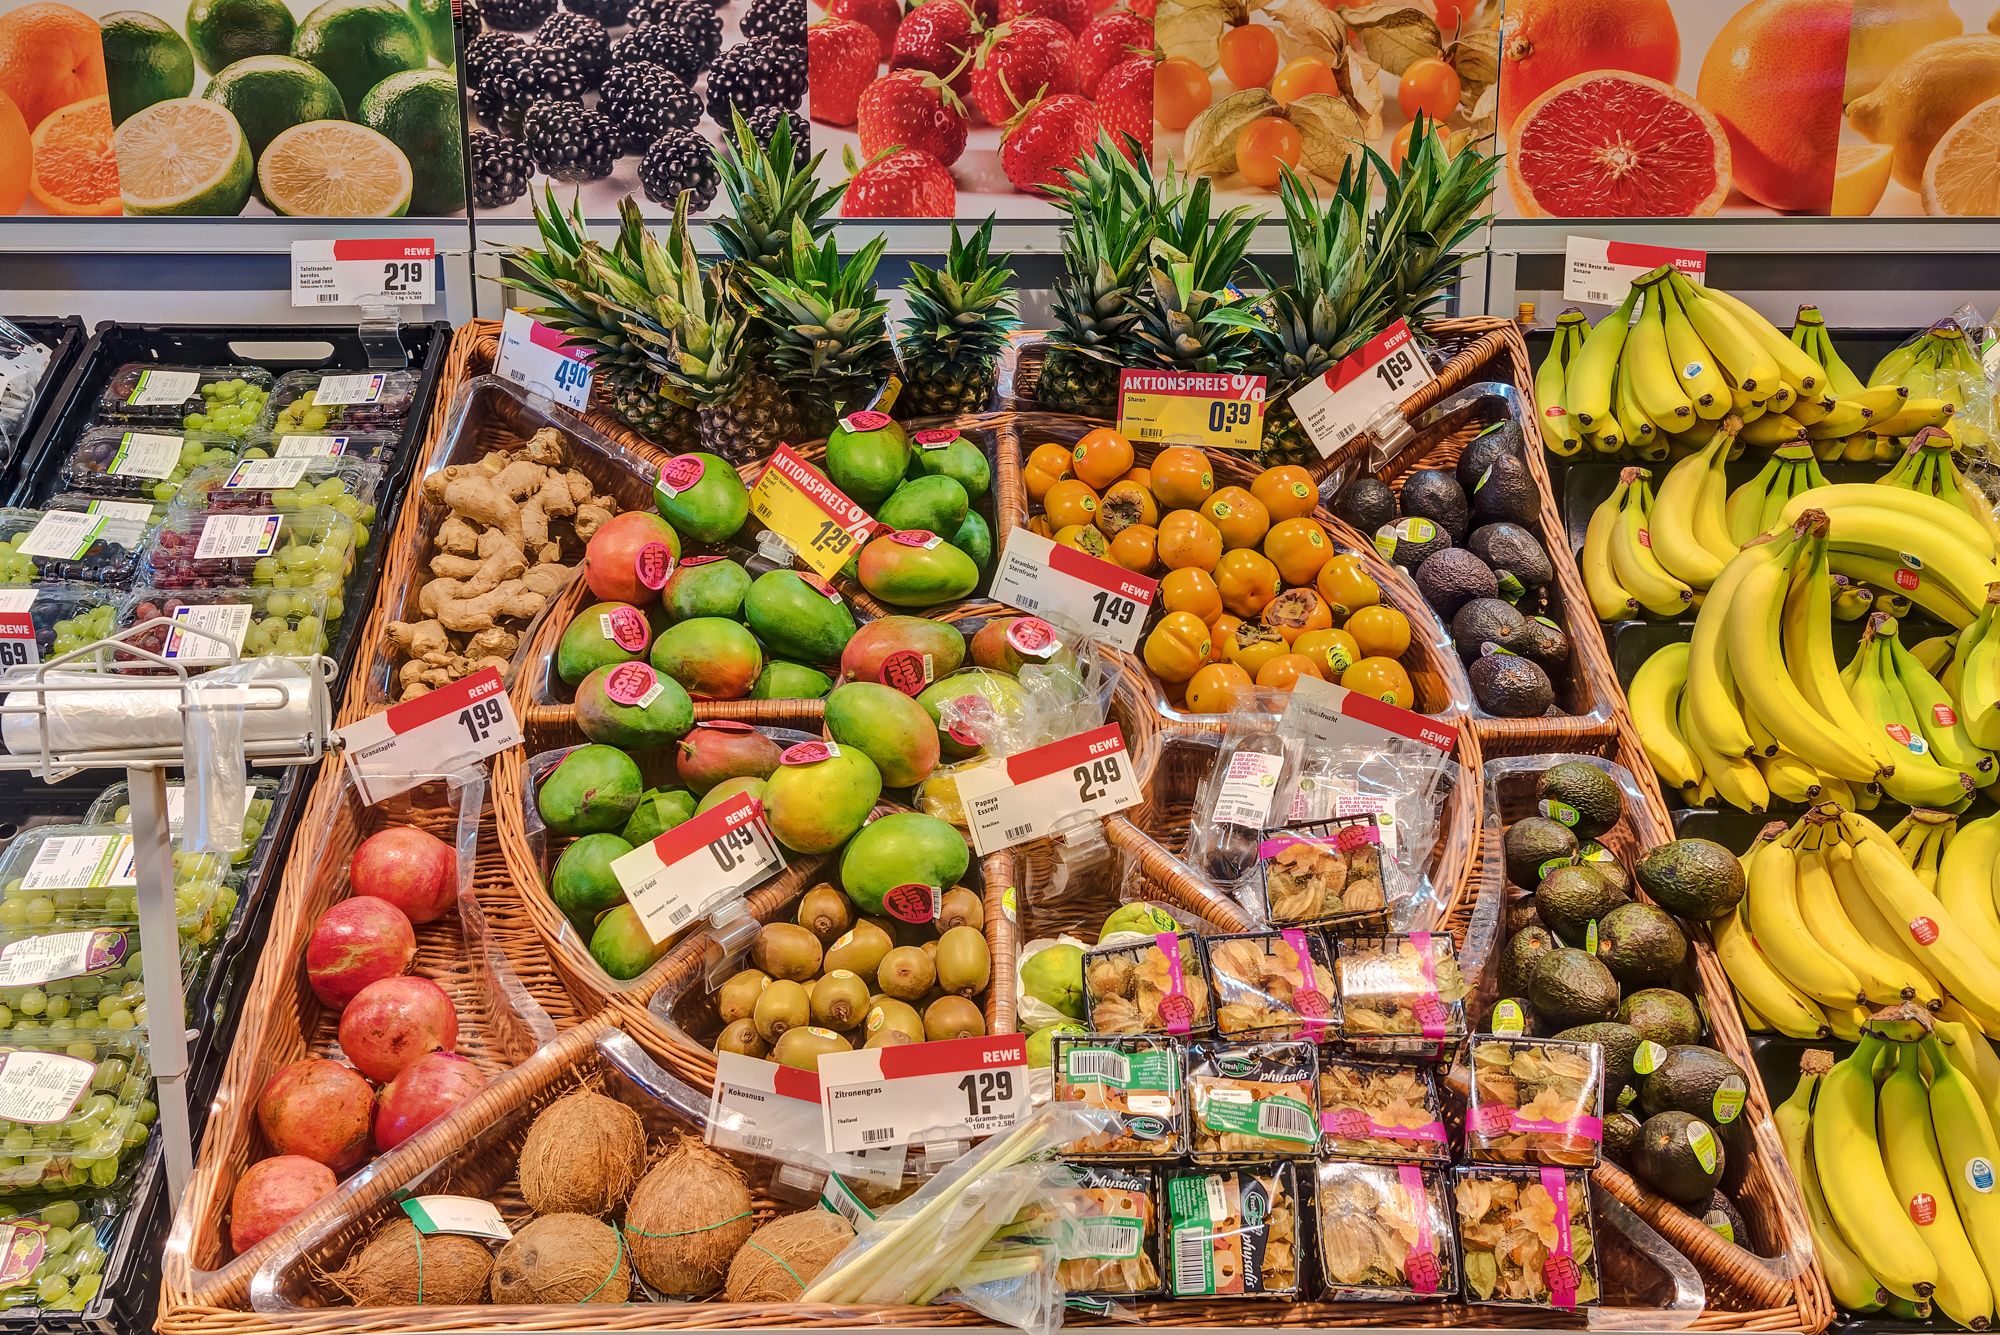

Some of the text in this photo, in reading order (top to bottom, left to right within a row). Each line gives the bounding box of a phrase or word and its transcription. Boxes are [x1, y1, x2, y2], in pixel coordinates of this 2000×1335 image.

[404, 247, 431, 256] REWE
[1675, 259, 1702, 268] REWE
[384, 262, 422, 290] 2.19
[1384, 329, 1408, 350] REWE
[554, 360, 588, 392] 4.90
[1376, 350, 1413, 392] 1.69
[1124, 376, 1228, 391] AKTIONSPREIS
[1412, 380, 1424, 390] Stück
[573, 396, 580, 407] kg
[1208, 402, 1252, 432] 0.39
[1307, 407, 1326, 422] Avocado
[1311, 415, 1326, 428] essreif
[1314, 425, 1326, 434] Hass
[666, 468, 695, 482] FRUIT
[669, 460, 700, 474] SOUL
[772, 452, 850, 516] AKTIONSPREIS
[810, 520, 852, 554] 1.29
[1008, 564, 1038, 580] Sternfrucht
[1011, 557, 1038, 572] Karambola
[1120, 582, 1150, 600] REWE
[1092, 591, 1136, 627] 1.49
[0, 624, 30, 634] REWE
[612, 664, 636, 696] SOUL
[624, 666, 648, 695] FRUIT
[468, 679, 499, 698] REWE
[458, 698, 504, 743] 1.99
[498, 736, 512, 745] Stück
[1420, 728, 1451, 746] REWE
[361, 740, 396, 760] Granatapfel
[1088, 737, 1120, 755] REWE
[1073, 756, 1122, 804] 2.49
[975, 797, 998, 808] Papaya
[1114, 796, 1129, 806] Stück
[725, 805, 753, 826] REWE
[977, 804, 999, 816] Essreif
[982, 820, 1000, 829] Brasilien
[708, 824, 754, 872] 0.49
[754, 857, 768, 868] Stück
[633, 878, 658, 898] Kiwi Gold
[983, 1048, 1020, 1063] REWE
[1260, 1069, 1309, 1084] physalis
[728, 1088, 765, 1102] Kokosnuss
[835, 1087, 882, 1098] Zitronengras
[958, 1071, 1012, 1115] 1.29
[965, 1113, 1016, 1124] 50-Gramm-Bund
[1089, 1174, 1142, 1192] physalis
[1242, 1233, 1258, 1288] physalis
